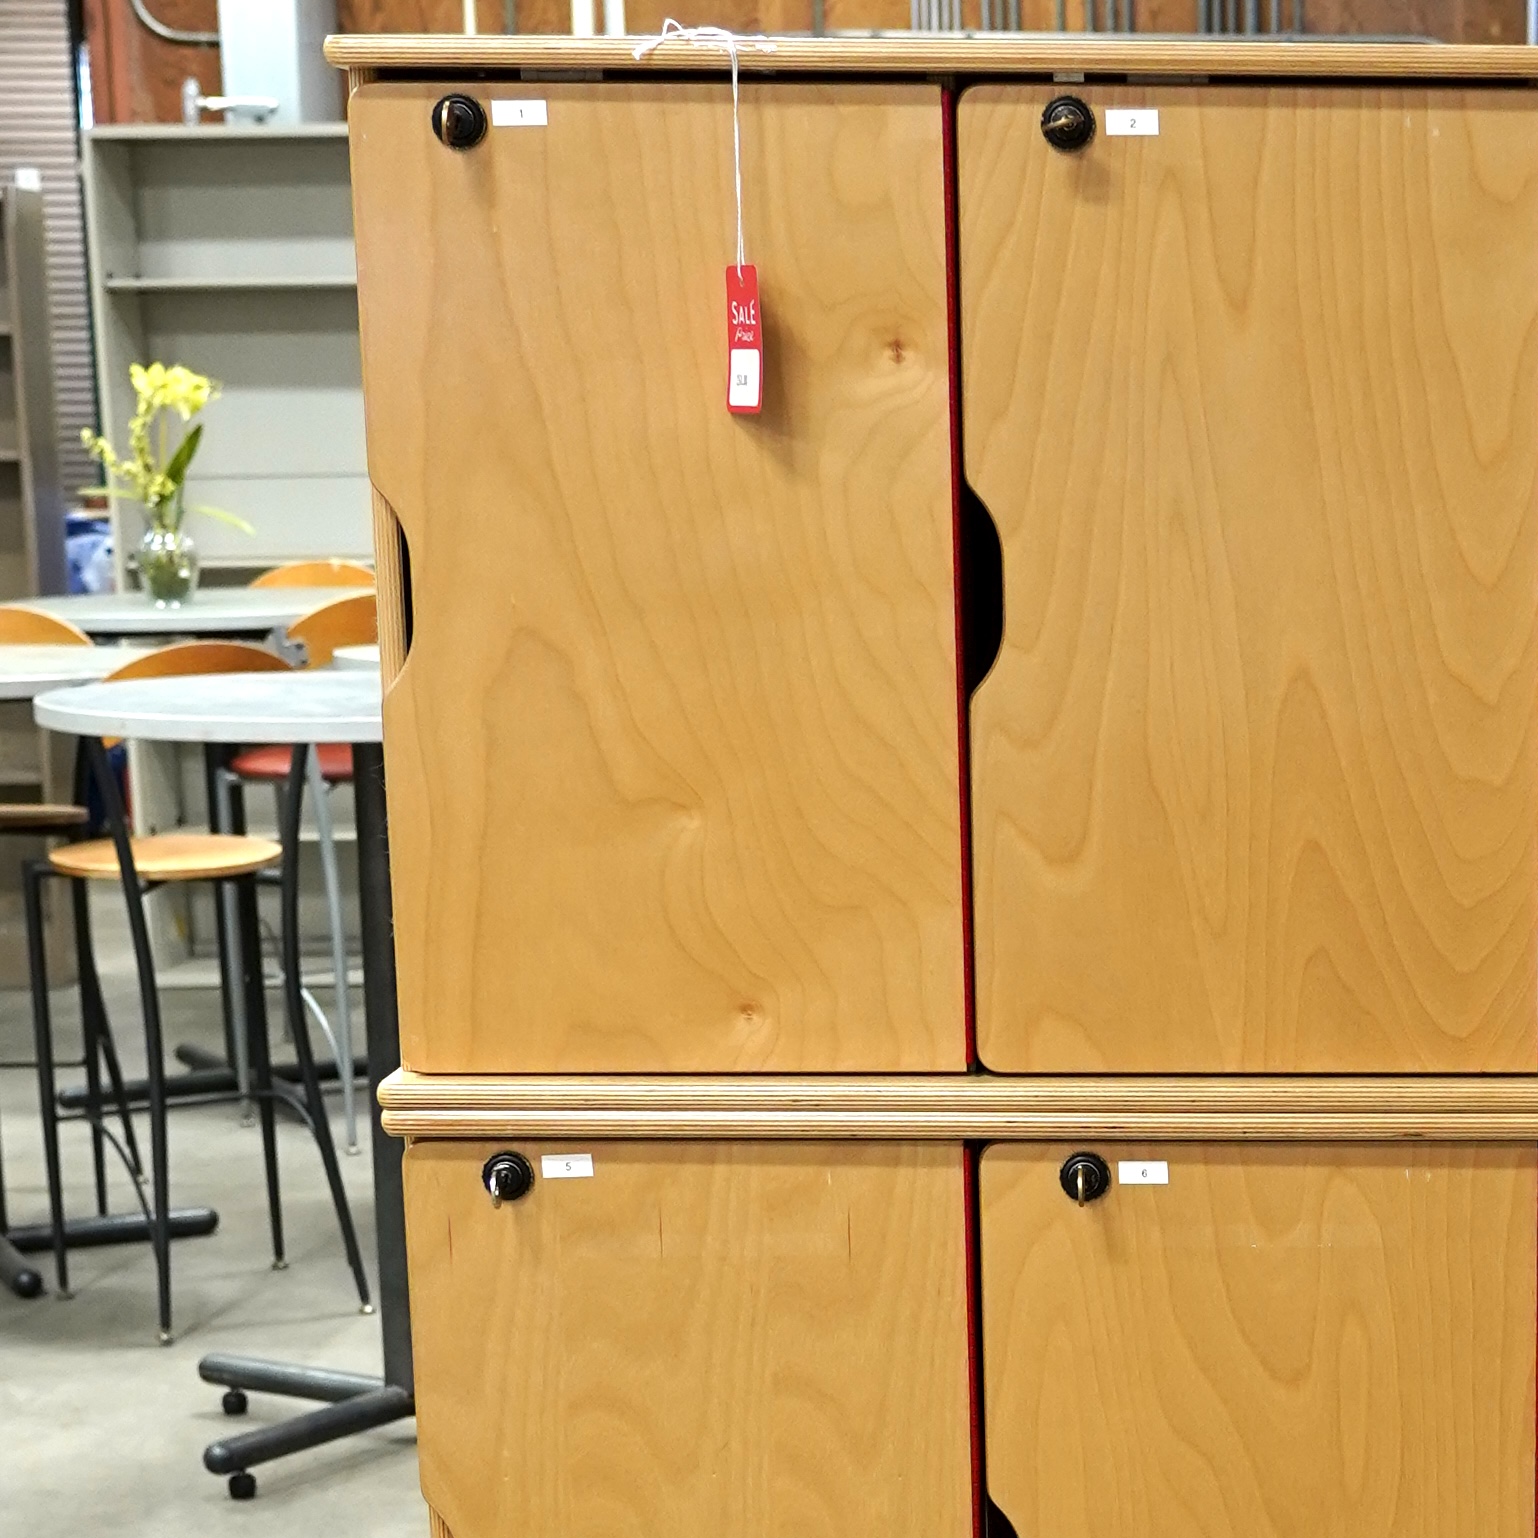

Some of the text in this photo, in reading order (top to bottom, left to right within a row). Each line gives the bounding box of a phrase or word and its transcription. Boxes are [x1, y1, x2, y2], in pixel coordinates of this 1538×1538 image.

[731, 300, 756, 325] SALE
[565, 1162, 572, 1172] 5
[1142, 1168, 1148, 1178] 6
